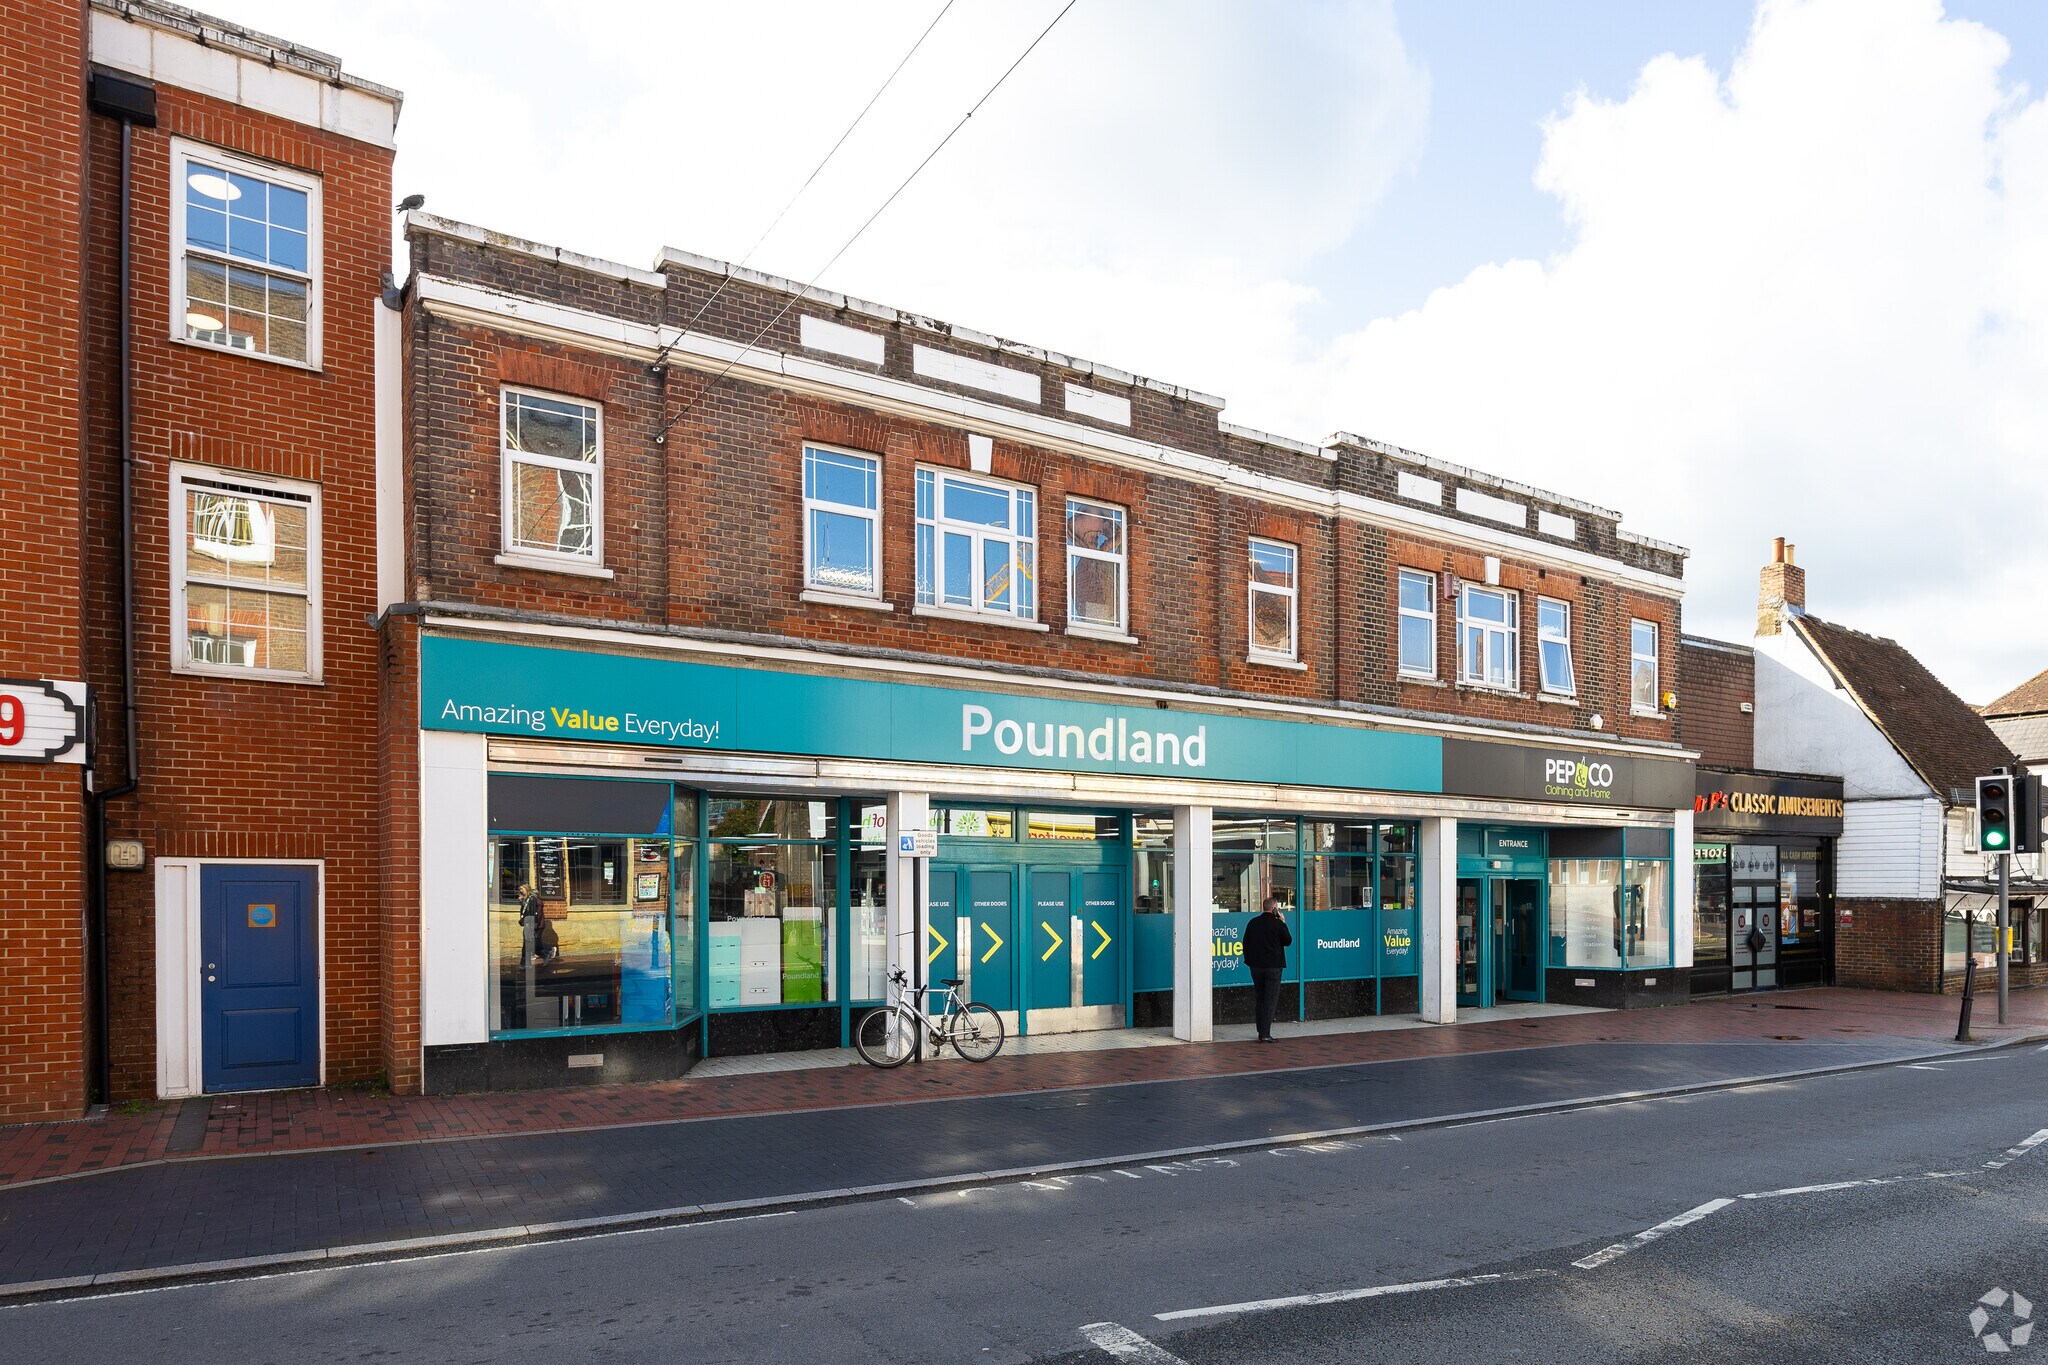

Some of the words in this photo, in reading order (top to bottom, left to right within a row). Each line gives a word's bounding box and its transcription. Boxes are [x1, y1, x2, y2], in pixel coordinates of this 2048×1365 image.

[441, 698, 546, 731] Amazing
[550, 707, 619, 731] Value
[625, 713, 719, 743] Everyday!
[962, 703, 1207, 767] Poundland
[1545, 784, 1574, 800] Clothing
[1574, 787, 1590, 798] and
[1590, 788, 1611, 799] Home
[1730, 791, 1776, 815] CLASSIC
[1777, 795, 1844, 818] AMUSEMENTS
[1498, 839, 1529, 848] ENTRANCE
[1386, 927, 1408, 936] Amazing
[1317, 938, 1360, 949] Poundland
[1384, 935, 1411, 947] Value
[1386, 948, 1409, 956] Everyday!
